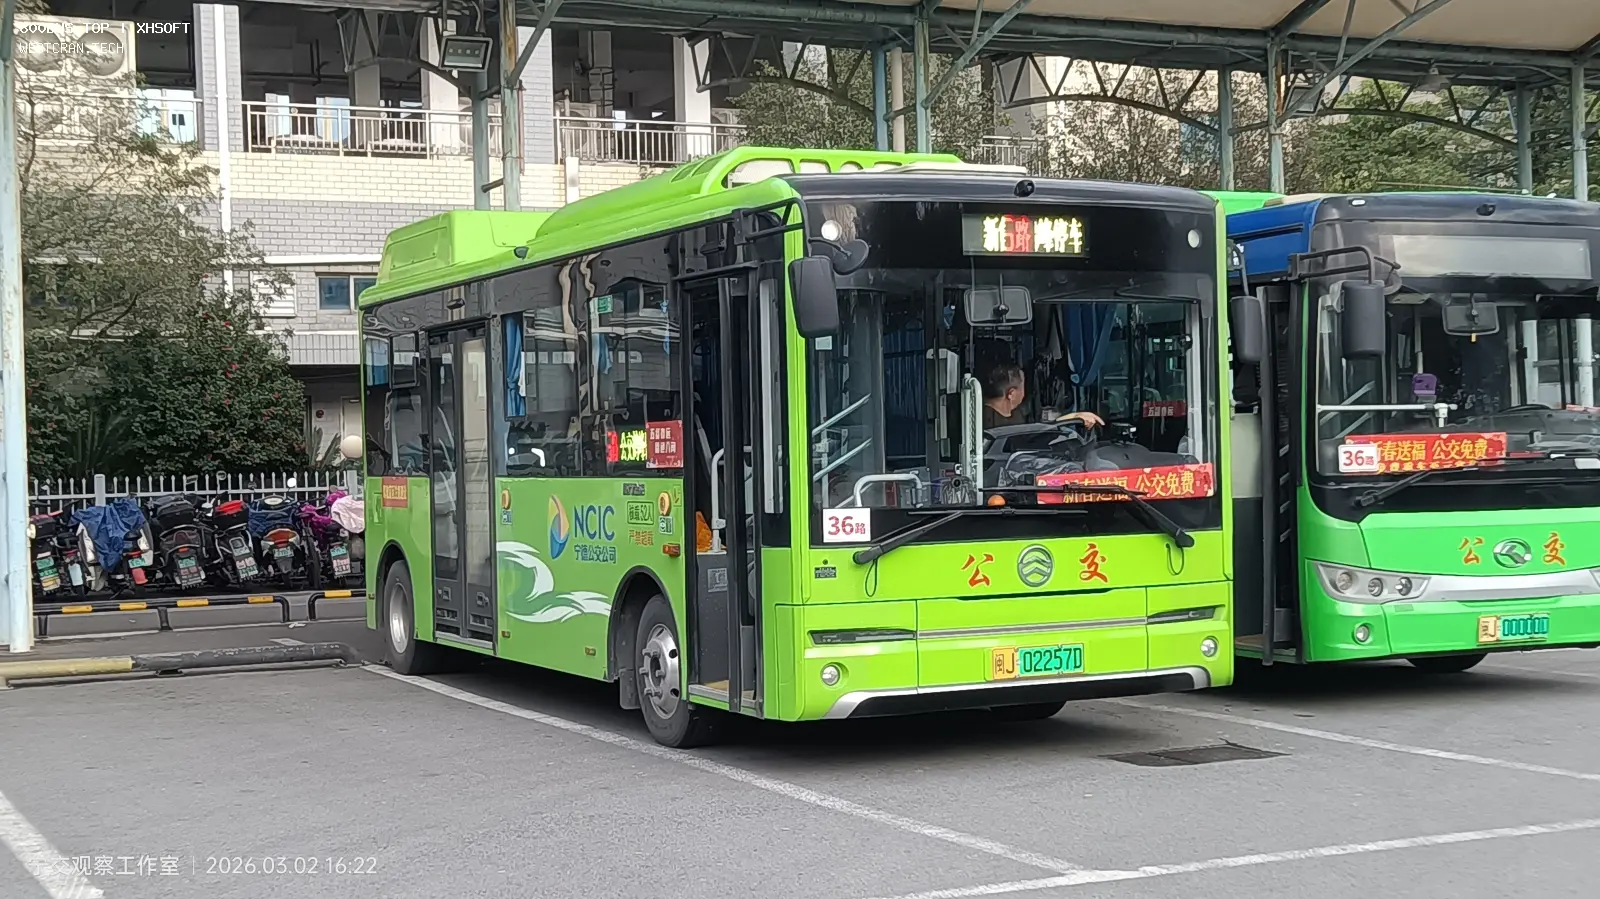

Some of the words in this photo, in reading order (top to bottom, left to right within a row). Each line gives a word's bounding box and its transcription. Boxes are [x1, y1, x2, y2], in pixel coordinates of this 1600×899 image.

[1432, 438, 1488, 460] 公交免费
[1136, 472, 1195, 498] 公交免费
[573, 505, 615, 540] NCIC
[828, 516, 866, 535] 36路
[574, 543, 617, 564] 宁德公交公司
[1458, 537, 1483, 564] 公
[1543, 532, 1566, 566] 交
[960, 553, 995, 588] 公
[1079, 542, 1109, 583] 交
